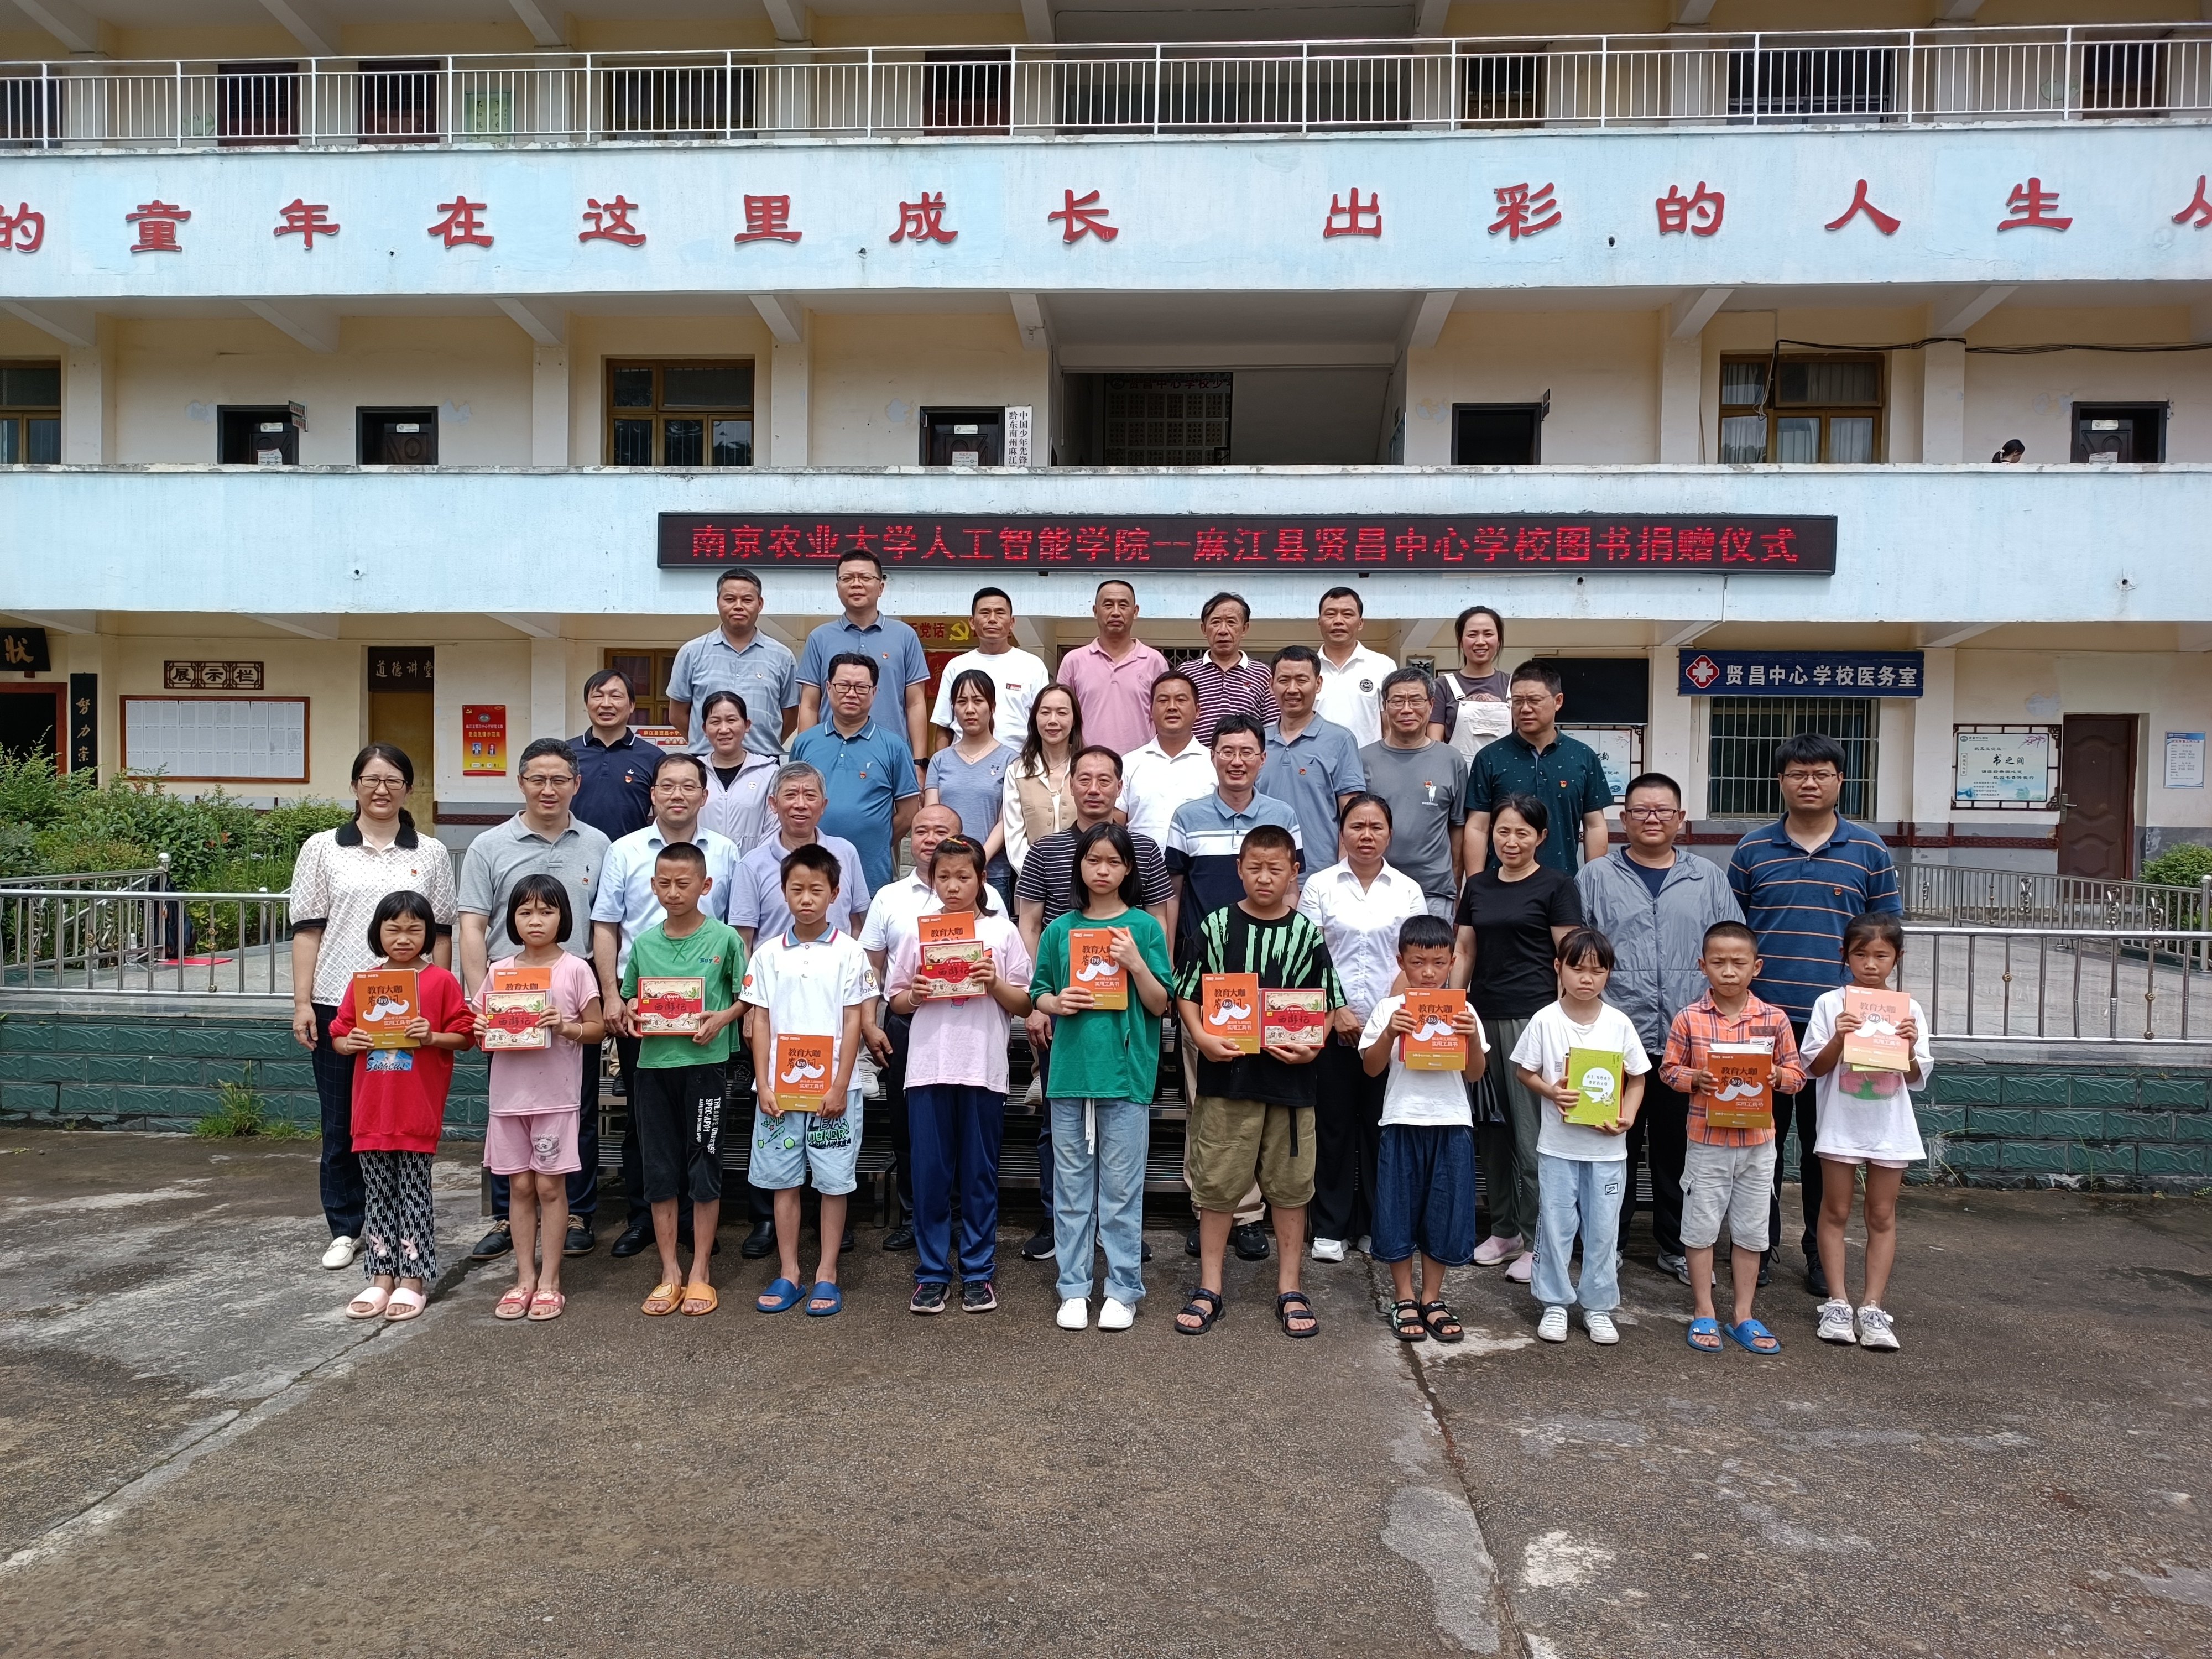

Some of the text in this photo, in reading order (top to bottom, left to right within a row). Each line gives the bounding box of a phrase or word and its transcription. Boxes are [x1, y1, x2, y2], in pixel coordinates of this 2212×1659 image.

[0, 189, 1118, 254] 的童年在这里成长
[1008, 411, 1018, 467] 黔东南州麻江
[4, 635, 34, 664] 状
[375, 660, 434, 678] 道德讲堂
[172, 667, 255, 682] 展示栏
[1725, 665, 1917, 687] 贤昌中心学校医务室
[930, 927, 963, 937] 教育大咖
[367, 985, 403, 994] 教育大咖
[1214, 988, 1246, 998] 教育大咖
[654, 1002, 687, 1012] 西游记
[1418, 1004, 1452, 1013] 教育大咖
[498, 1016, 531, 1026] 西游记
[1277, 1015, 1310, 1025] 西游记
[788, 1048, 821, 1057] 教育大咖
[1721, 1067, 1758, 1075] 教育大咖
